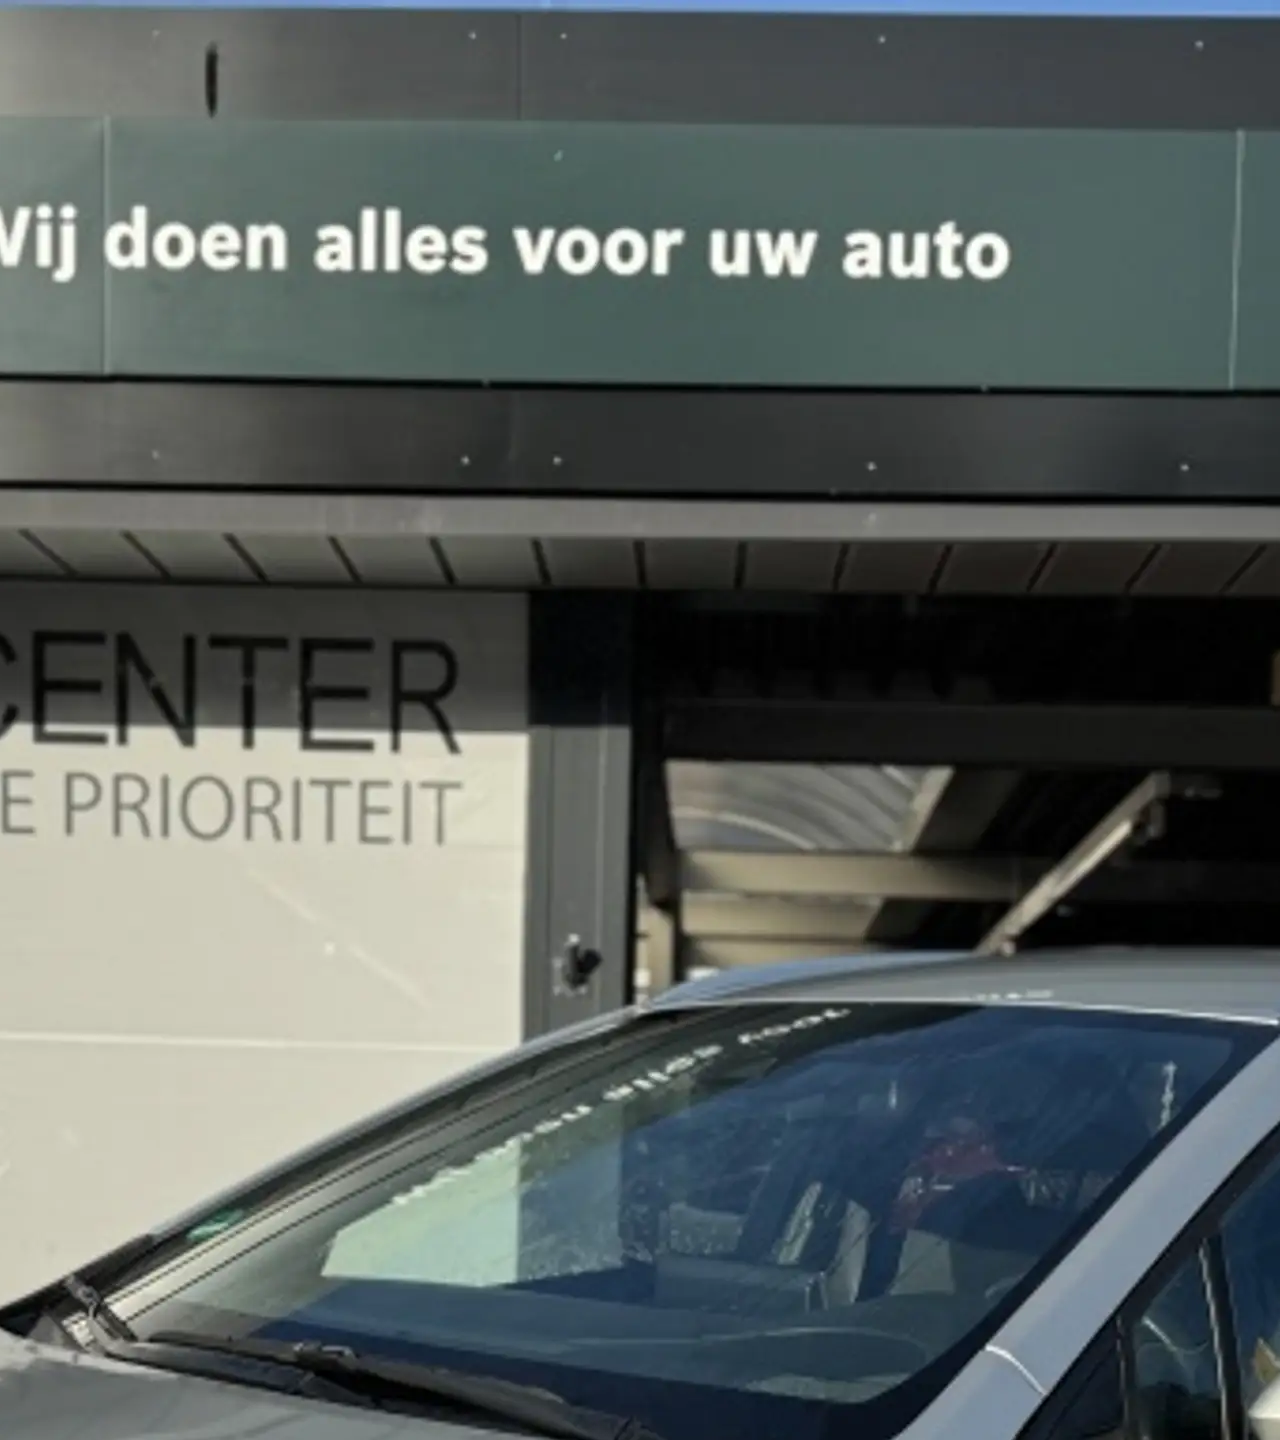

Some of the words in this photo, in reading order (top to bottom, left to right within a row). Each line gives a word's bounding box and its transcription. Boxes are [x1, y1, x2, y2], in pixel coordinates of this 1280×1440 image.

[104, 207, 288, 273] doen
[313, 207, 489, 274] alles
[514, 226, 685, 278] voor
[709, 228, 817, 279] uw
[842, 221, 1011, 281] auto
[63, 771, 464, 847] PRIORITEIT
